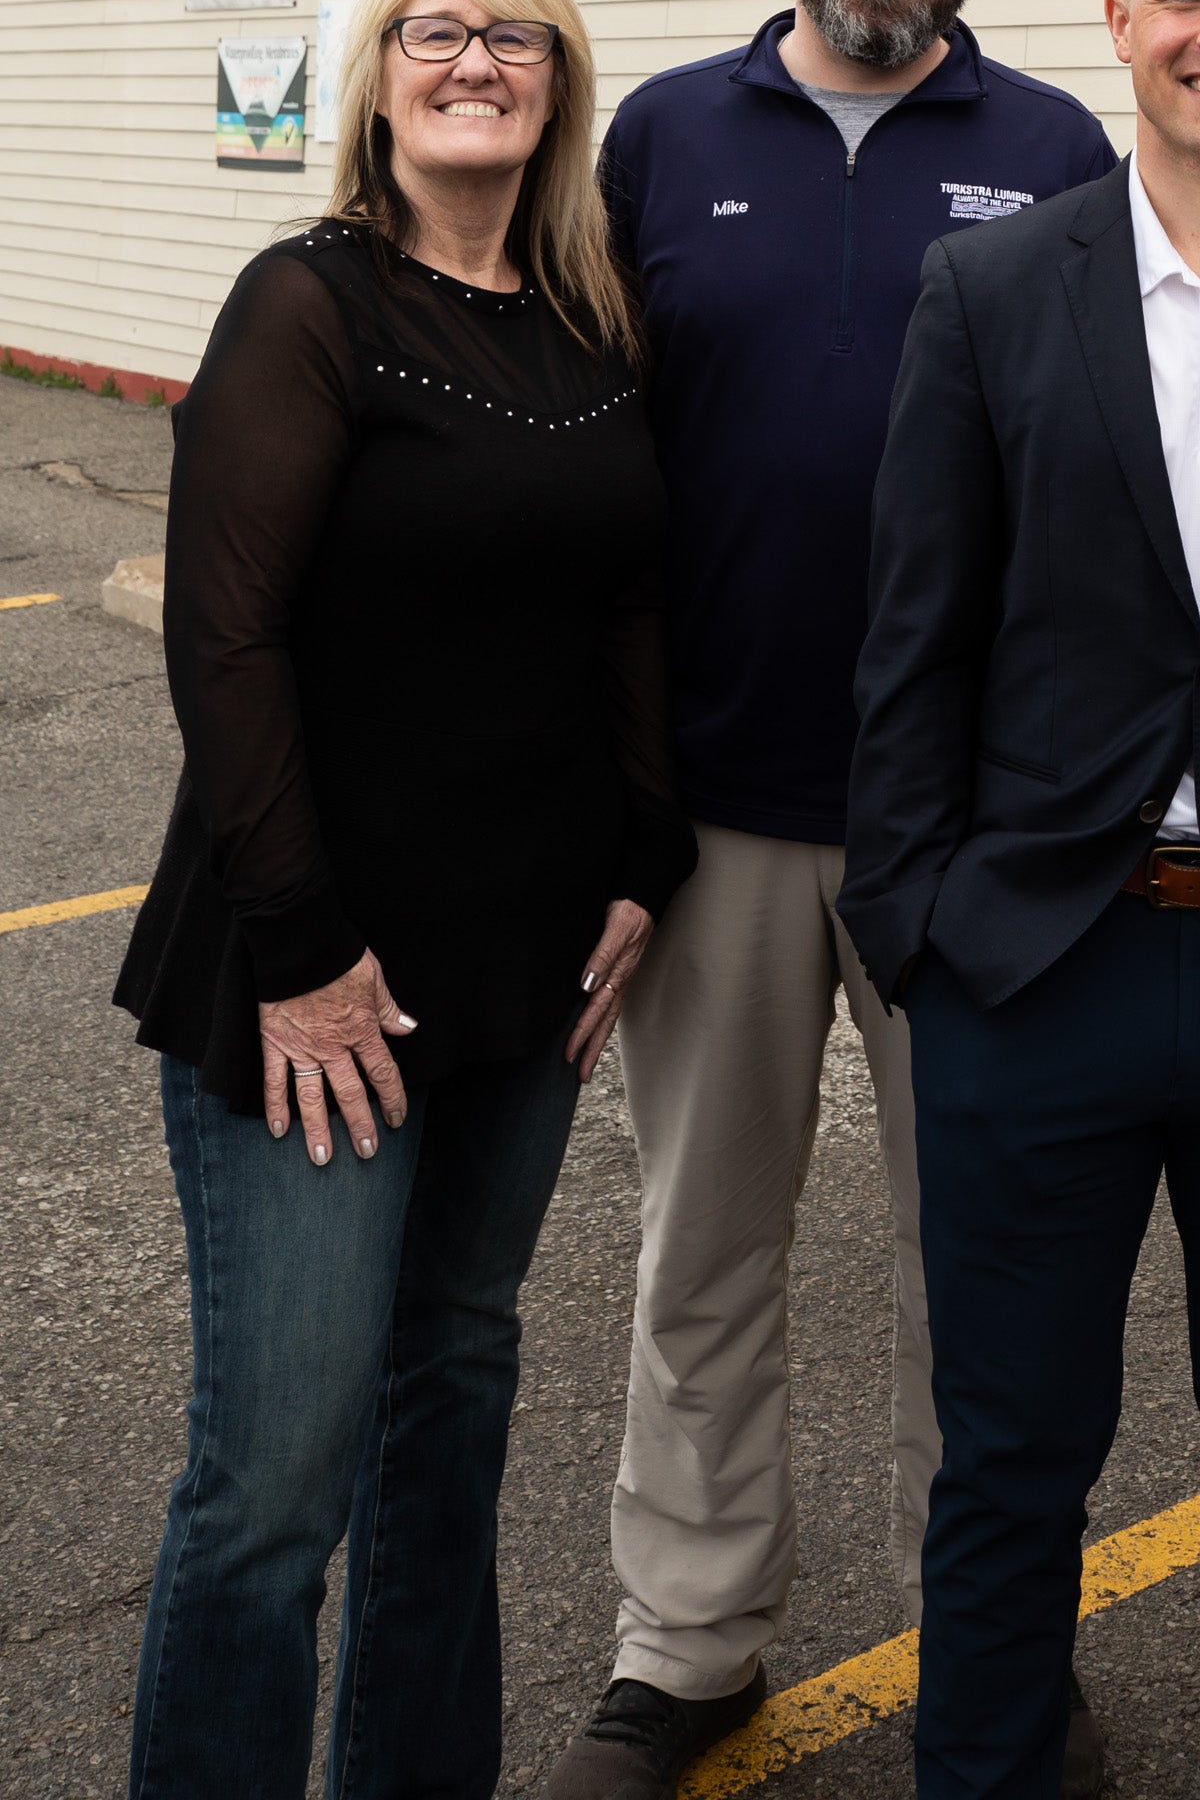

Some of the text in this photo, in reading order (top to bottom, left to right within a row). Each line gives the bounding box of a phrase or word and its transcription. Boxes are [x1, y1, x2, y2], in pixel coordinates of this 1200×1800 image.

[940, 182, 1034, 205] TURKSTRA LUMBER
[952, 193, 979, 203] ALWAYS
[989, 198, 1002, 207] THE
[1002, 200, 1022, 210] LEVEL
[712, 199, 749, 218] Mike
